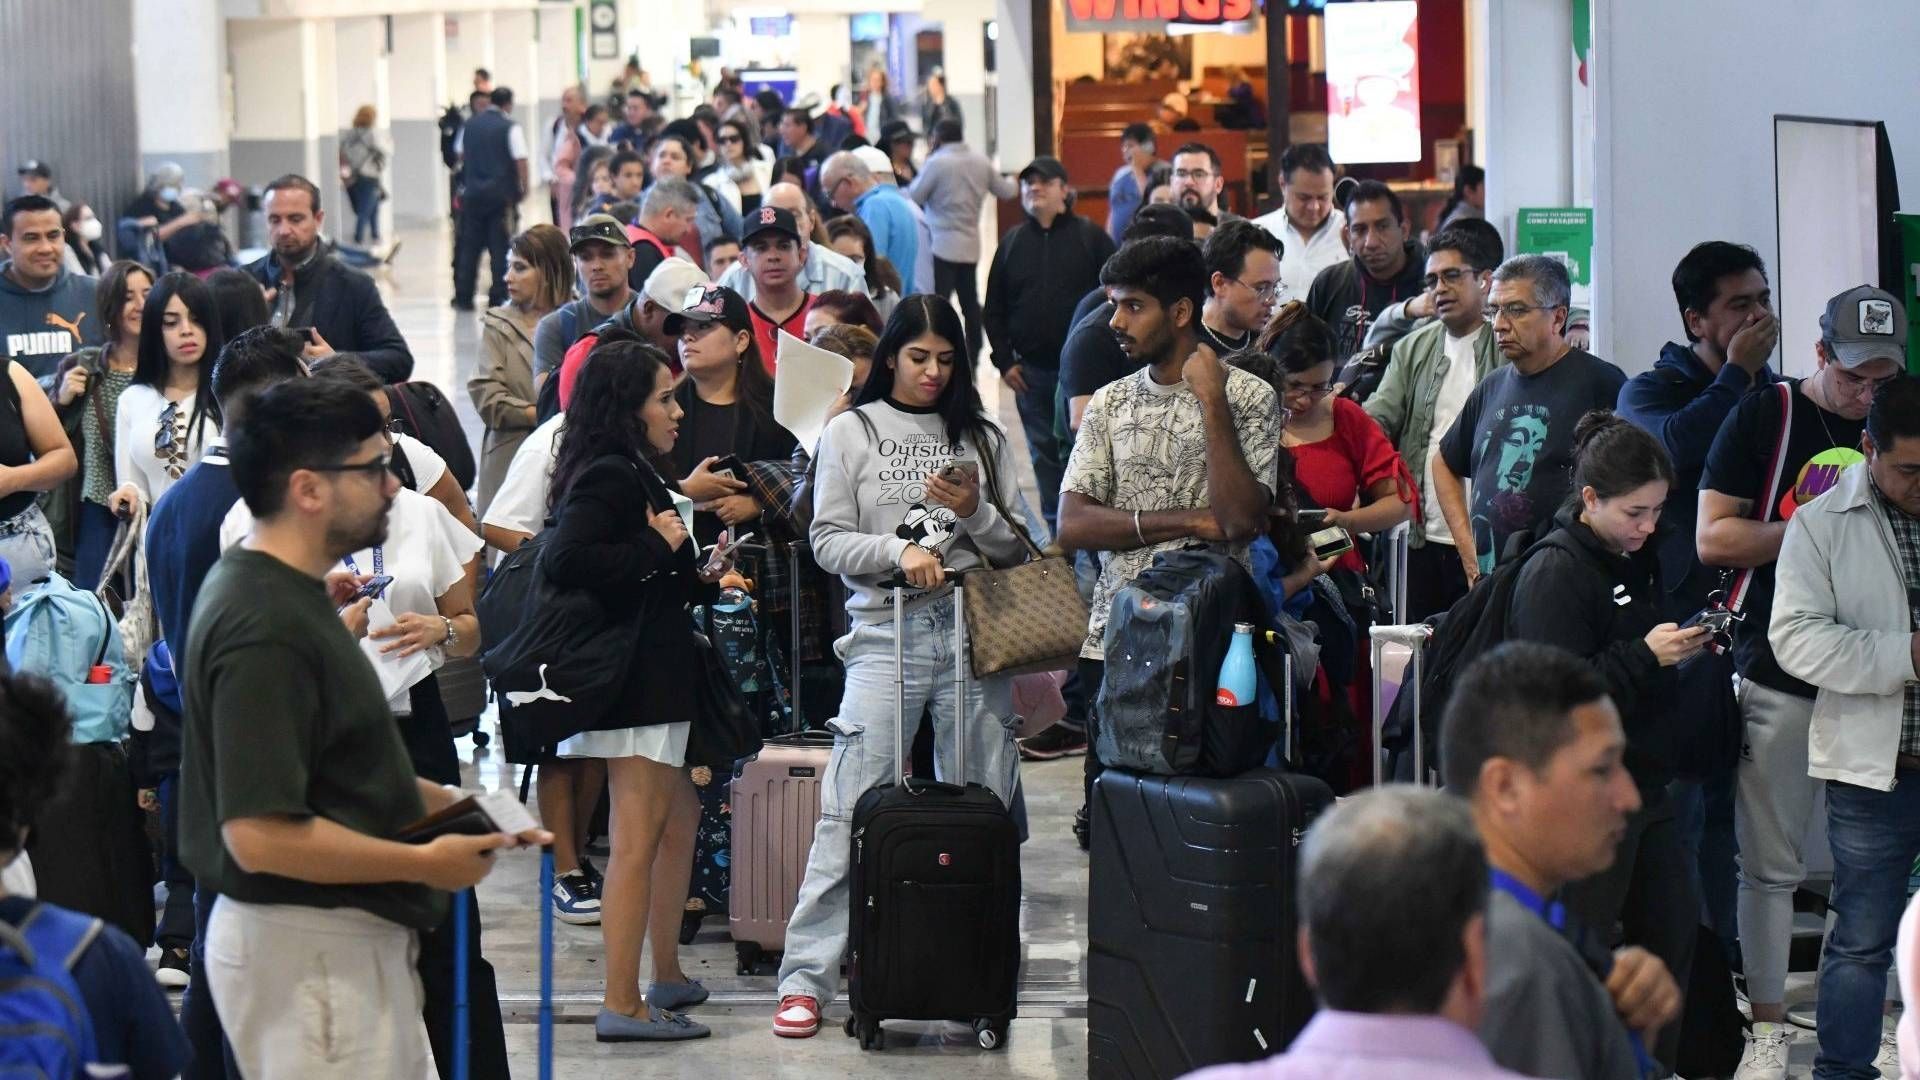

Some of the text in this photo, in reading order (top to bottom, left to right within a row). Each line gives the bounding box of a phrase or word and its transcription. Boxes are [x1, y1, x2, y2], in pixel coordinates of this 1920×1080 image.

[6, 331, 72, 357] PUMA
[879, 439, 965, 457] Outside
[890, 453, 909, 468] of
